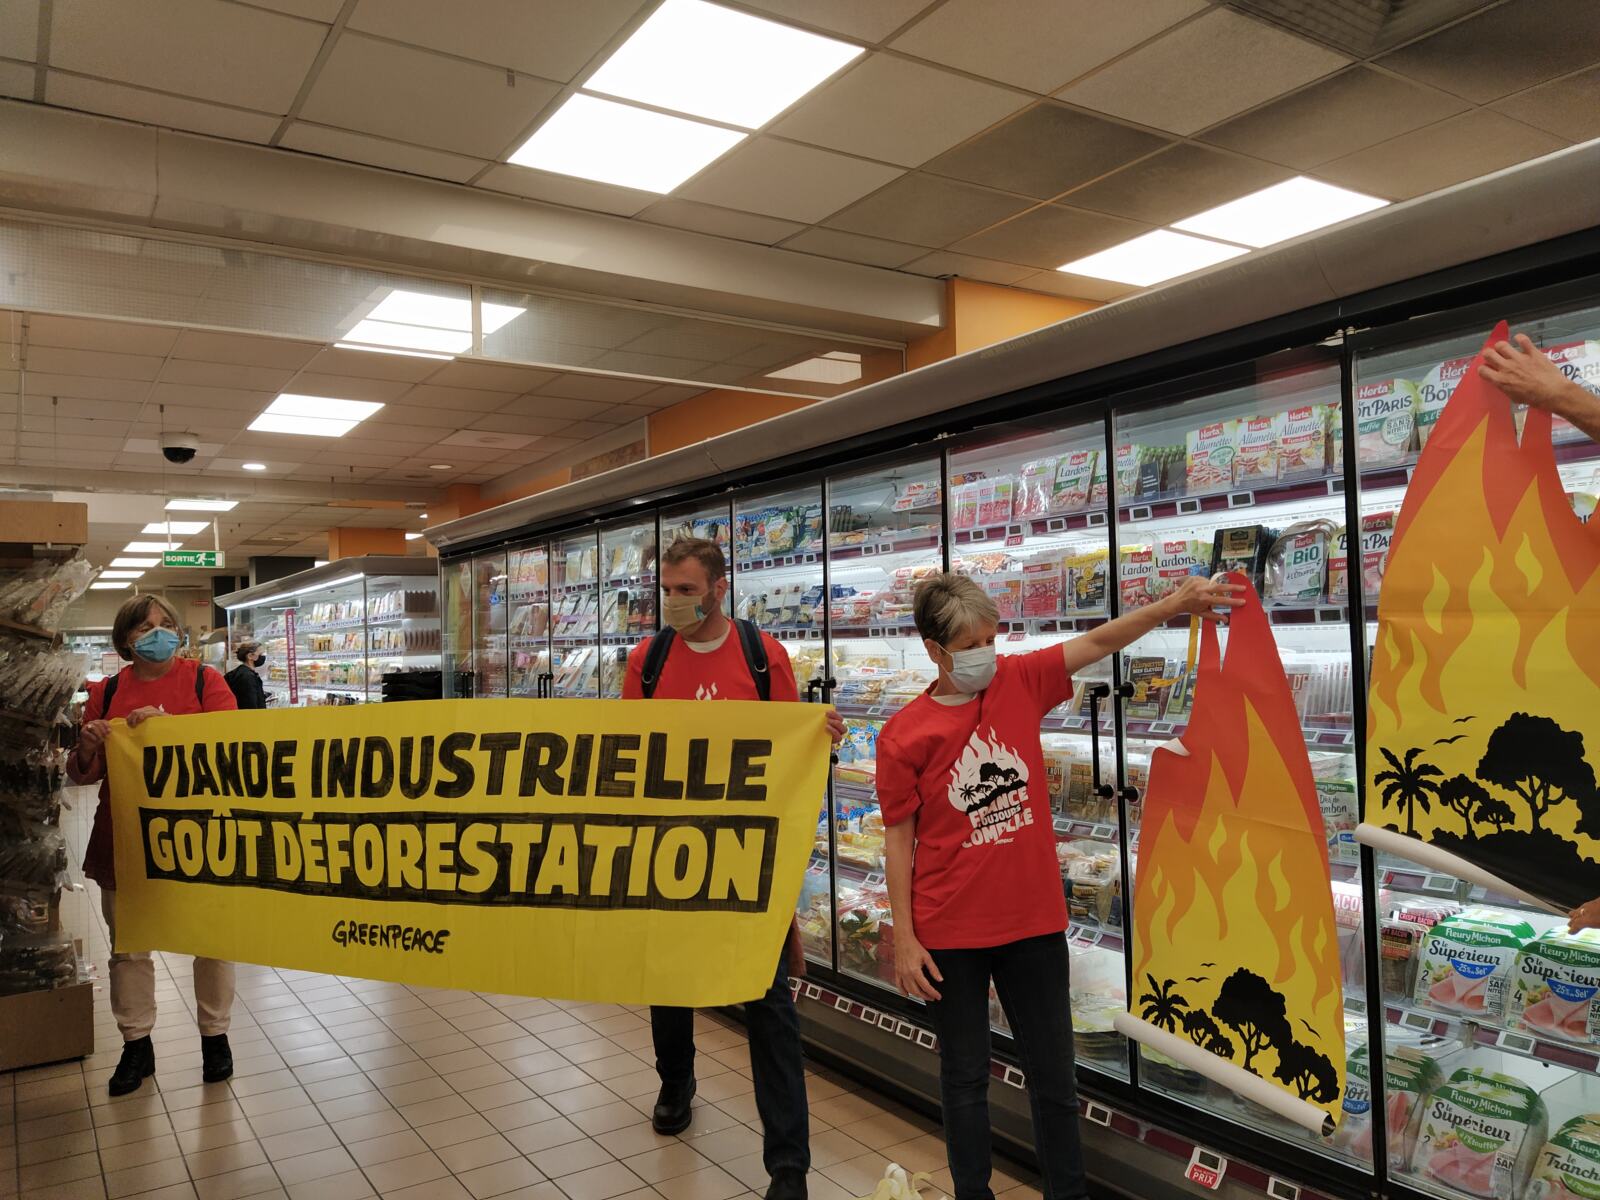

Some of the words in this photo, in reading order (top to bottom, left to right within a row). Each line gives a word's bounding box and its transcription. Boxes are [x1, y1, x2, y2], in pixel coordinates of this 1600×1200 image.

[1442, 364, 1470, 379] Hert
[1359, 383, 1388, 399] Herta
[1421, 384, 1449, 403] Bo
[1371, 395, 1412, 416] PARIS
[1060, 464, 1091, 477] Lardons
[1165, 543, 1183, 554] Herta
[1155, 554, 1197, 568] Lardons
[143, 739, 297, 799] VIANDE
[311, 731, 773, 801] INDUSTRIELLE
[148, 809, 264, 877] GOÛT
[271, 812, 766, 902] DÉFORESTATION
[332, 919, 451, 954] GREENPEACE
[1445, 927, 1471, 942] Fleury
[1471, 931, 1501, 944] Michon
[1429, 939, 1501, 966] Supérieur
[1540, 944, 1569, 960] Fleury
[1421, 969, 1429, 982] 2
[1514, 988, 1523, 1002] 4
[1450, 1089, 1479, 1108] Fleury
[1479, 1097, 1512, 1118] Michon
[1432, 1101, 1512, 1142] Supérieur
[1544, 1151, 1600, 1181] Tranch
[1192, 1171, 1214, 1185] PRIX
